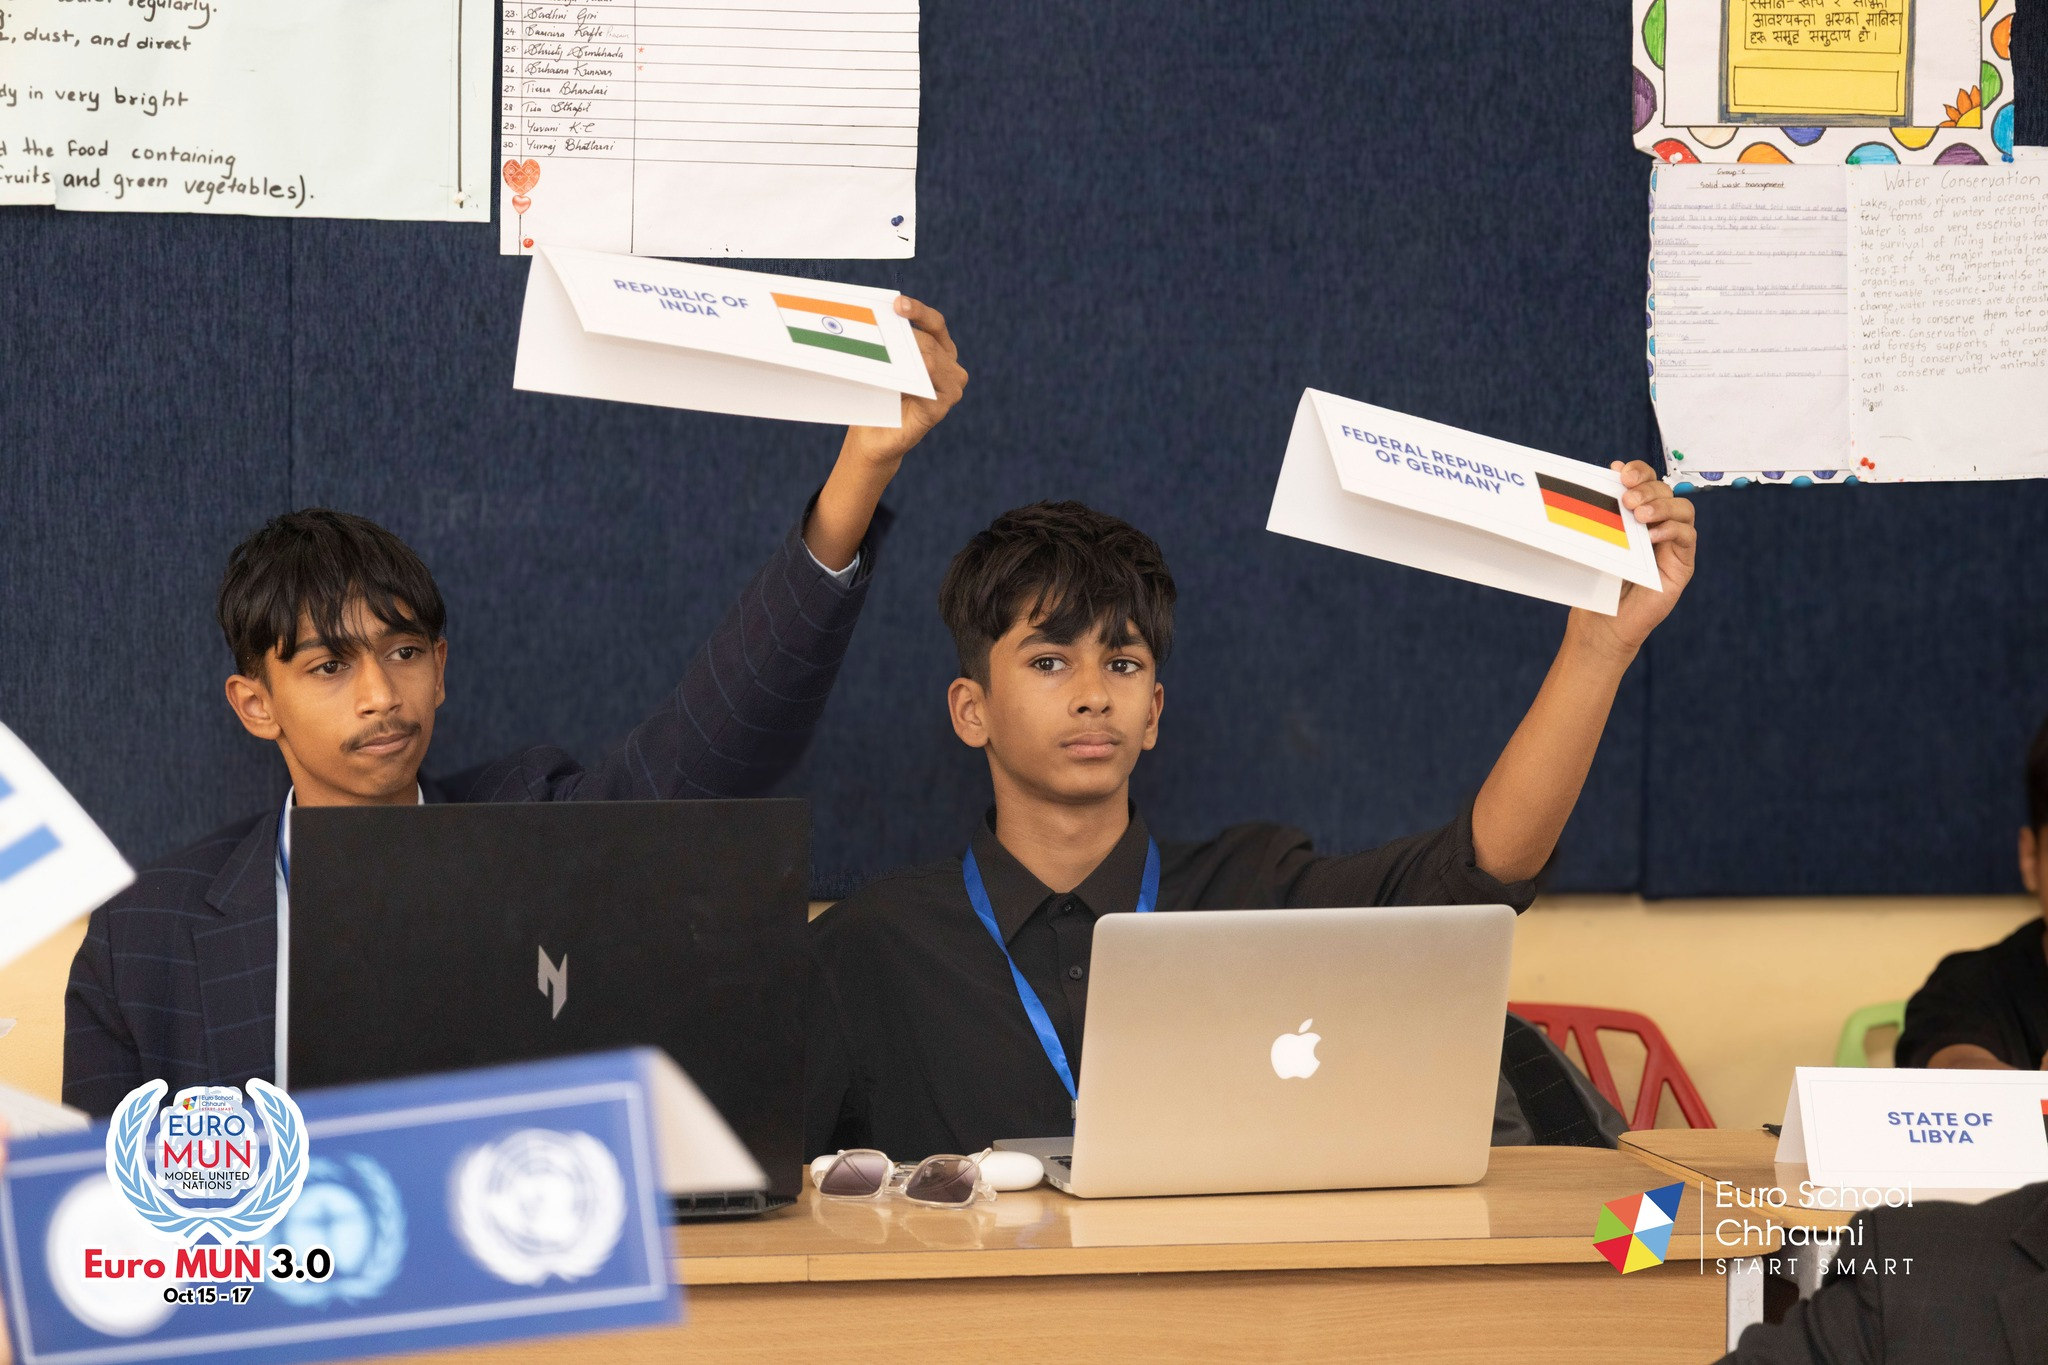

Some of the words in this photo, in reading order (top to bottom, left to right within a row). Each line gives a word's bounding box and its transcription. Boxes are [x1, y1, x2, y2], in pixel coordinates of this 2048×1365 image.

[24, 27, 80, 47] dust,
[90, 33, 130, 48] and
[137, 36, 191, 51] direct
[29, 86, 43, 99] in
[56, 90, 100, 111] very
[115, 87, 188, 116] bright
[23, 137, 54, 157] the
[132, 145, 236, 179] containing
[63, 168, 100, 188] and
[114, 174, 168, 199] green
[185, 174, 314, 209] vegetables).
[1884, 170, 1931, 191] Water
[1941, 170, 2041, 190] Conservation
[1973, 191, 1991, 202] and
[1998, 193, 2035, 202] oceans
[1889, 208, 1923, 221] forms
[1953, 205, 1984, 218] water
[1899, 224, 1906, 236] is
[1914, 223, 1935, 234] also
[1948, 225, 1968, 237] very
[1976, 216, 2026, 230] essential
[1861, 240, 1874, 250] the
[1881, 237, 1924, 249] survival
[1934, 235, 1946, 248] of
[1954, 233, 1984, 249] living
[1862, 253, 1869, 263] is
[1877, 254, 1894, 263] one
[1903, 250, 1914, 262] of
[1924, 251, 1940, 262] the
[1964, 257, 2016, 274] important
[2025, 254, 2041, 266] for
[1923, 274, 1940, 285] for
[613, 279, 717, 304] REPUBLIC
[722, 295, 748, 309] OF
[659, 298, 720, 318] INDIA
[1861, 315, 1875, 326] We
[1883, 313, 1905, 325] have
[1912, 313, 1921, 324] to
[1927, 315, 1975, 325] conserve
[1983, 308, 2008, 320] them
[2014, 305, 2032, 317] for
[1984, 323, 1995, 336] of
[1862, 339, 1881, 350] and
[1936, 338, 1987, 352] supports
[2000, 337, 2009, 347] to
[1864, 352, 1897, 364] water
[1921, 351, 1982, 364] conserving
[1990, 347, 2024, 360] water
[1861, 371, 1882, 379] can
[1897, 367, 1946, 378] conserve
[1956, 363, 1991, 375] water
[2001, 358, 2045, 370] animals
[1863, 383, 1885, 394] well
[1341, 425, 1428, 459] FEDERAL
[1431, 450, 1525, 487] REPUBLIC
[1375, 449, 1401, 466] OF
[1406, 457, 1501, 495] GERMANY
[1887, 1111, 1958, 1127] STATE
[1964, 1112, 1993, 1127] OF
[1909, 1129, 1974, 1144] LIBYA
